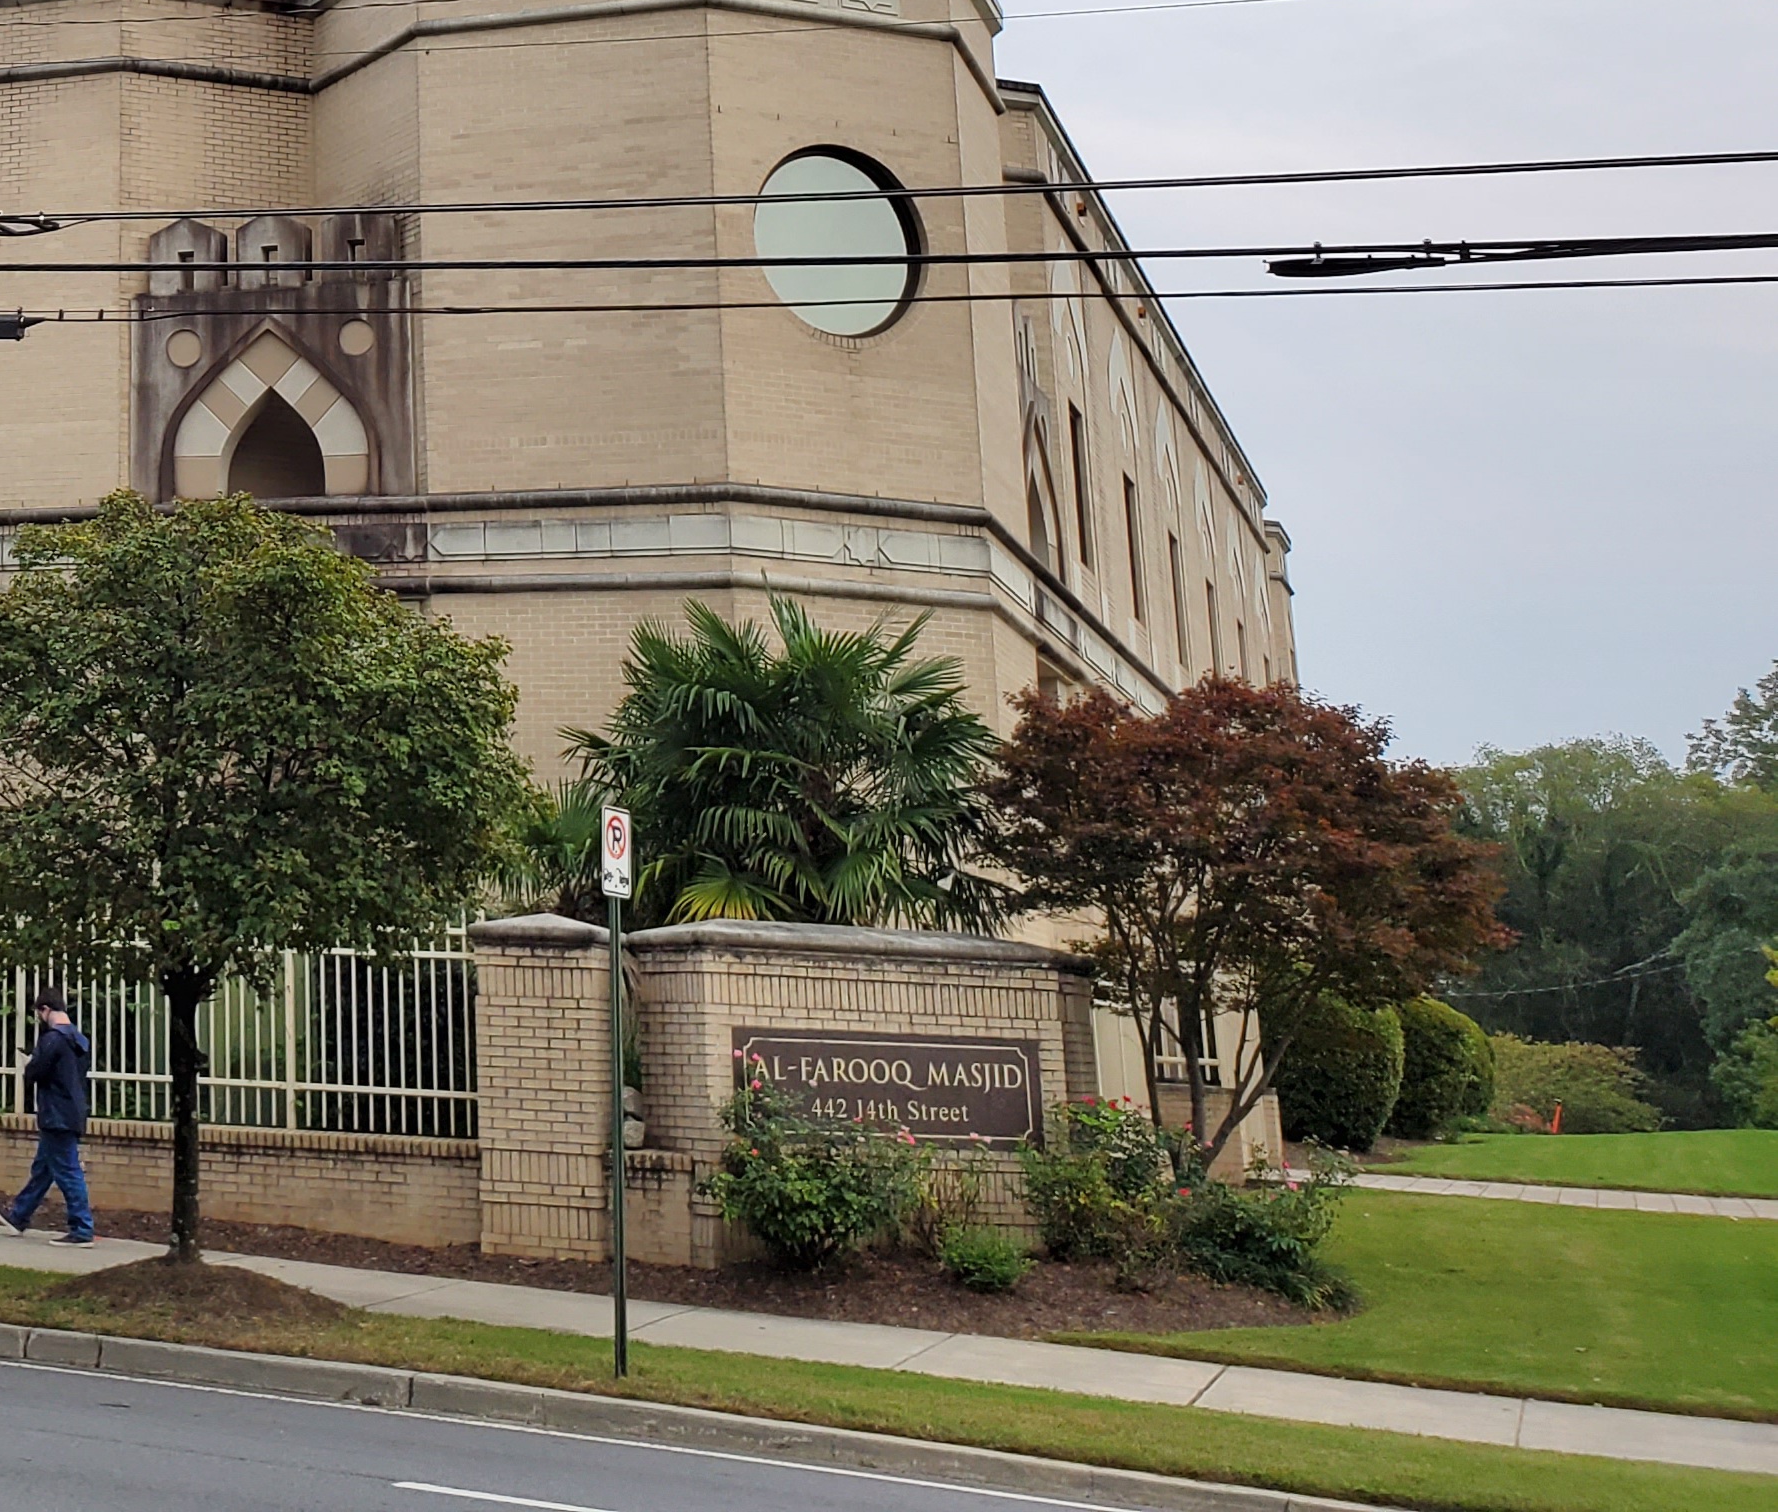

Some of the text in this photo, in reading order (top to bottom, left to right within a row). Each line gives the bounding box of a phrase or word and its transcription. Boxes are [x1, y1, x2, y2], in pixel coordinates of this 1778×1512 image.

[754, 1055, 1023, 1094] AL-FAROOQ MASJID
[810, 1096, 970, 1122] 442 14th Street
